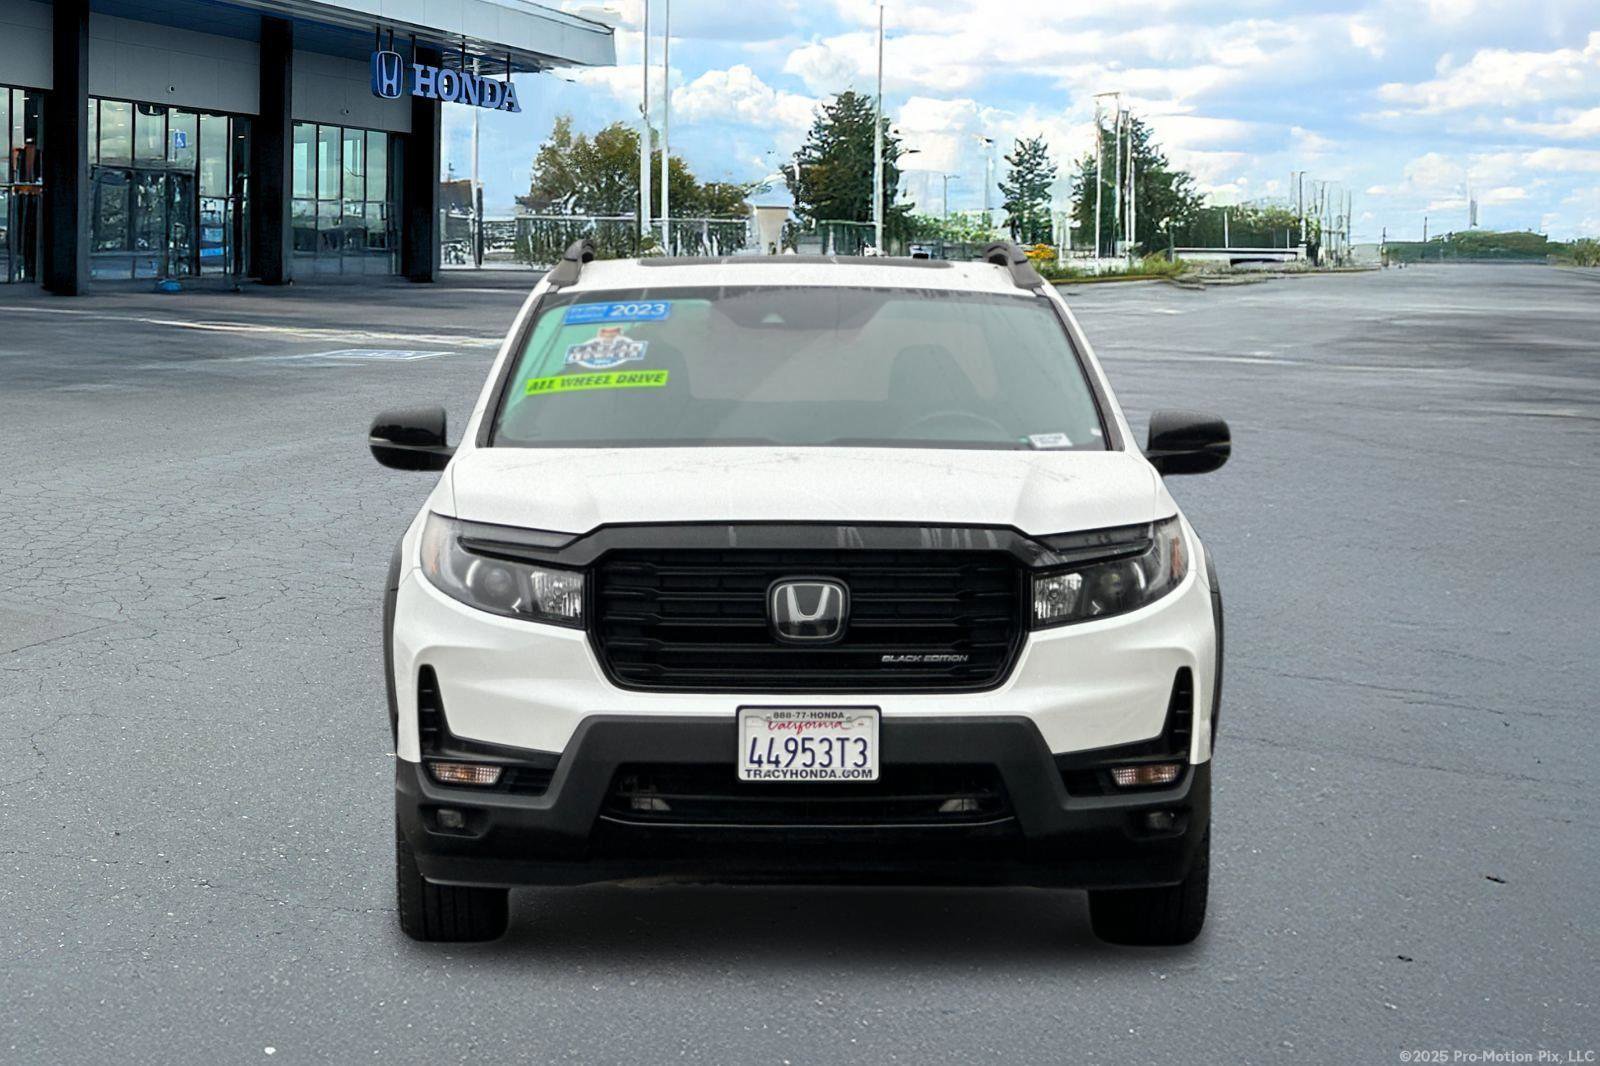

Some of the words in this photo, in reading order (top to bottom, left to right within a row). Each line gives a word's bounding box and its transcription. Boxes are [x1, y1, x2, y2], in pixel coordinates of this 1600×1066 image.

[412, 63, 522, 112] HONDA
[610, 303, 666, 317] 2023
[527, 377, 556, 392] ALL
[561, 373, 612, 387] WHEEL
[615, 371, 665, 384] DRIVE
[923, 654, 969, 662] EDITION
[773, 711, 845, 719] 888-77-HONDA
[767, 720, 851, 734] California
[749, 737, 868, 768] 44953T3
[745, 769, 873, 779] TRACYHONDA.COM
